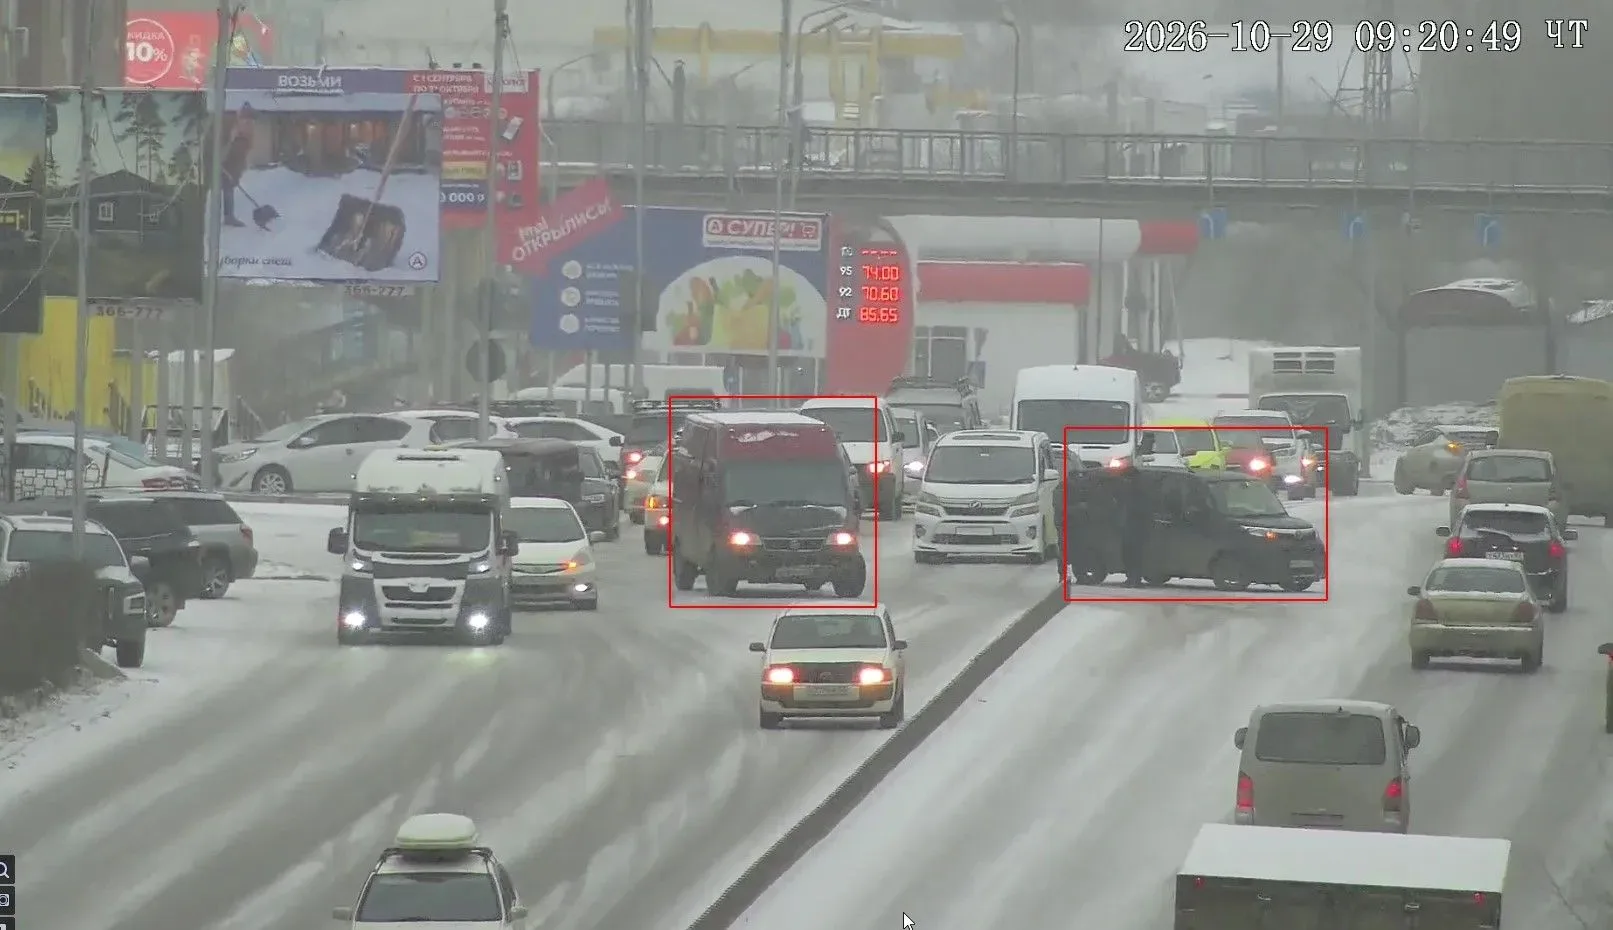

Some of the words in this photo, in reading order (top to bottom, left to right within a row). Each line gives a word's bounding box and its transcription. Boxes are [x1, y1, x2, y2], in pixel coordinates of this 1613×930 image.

[126, 31, 166, 40] КИДКА
[278, 75, 342, 88] ВОЗЬМИ
[840, 265, 853, 276] 95
[839, 286, 853, 297] 92
[861, 286, 899, 301] 70.60
[836, 307, 852, 319] ДТ
